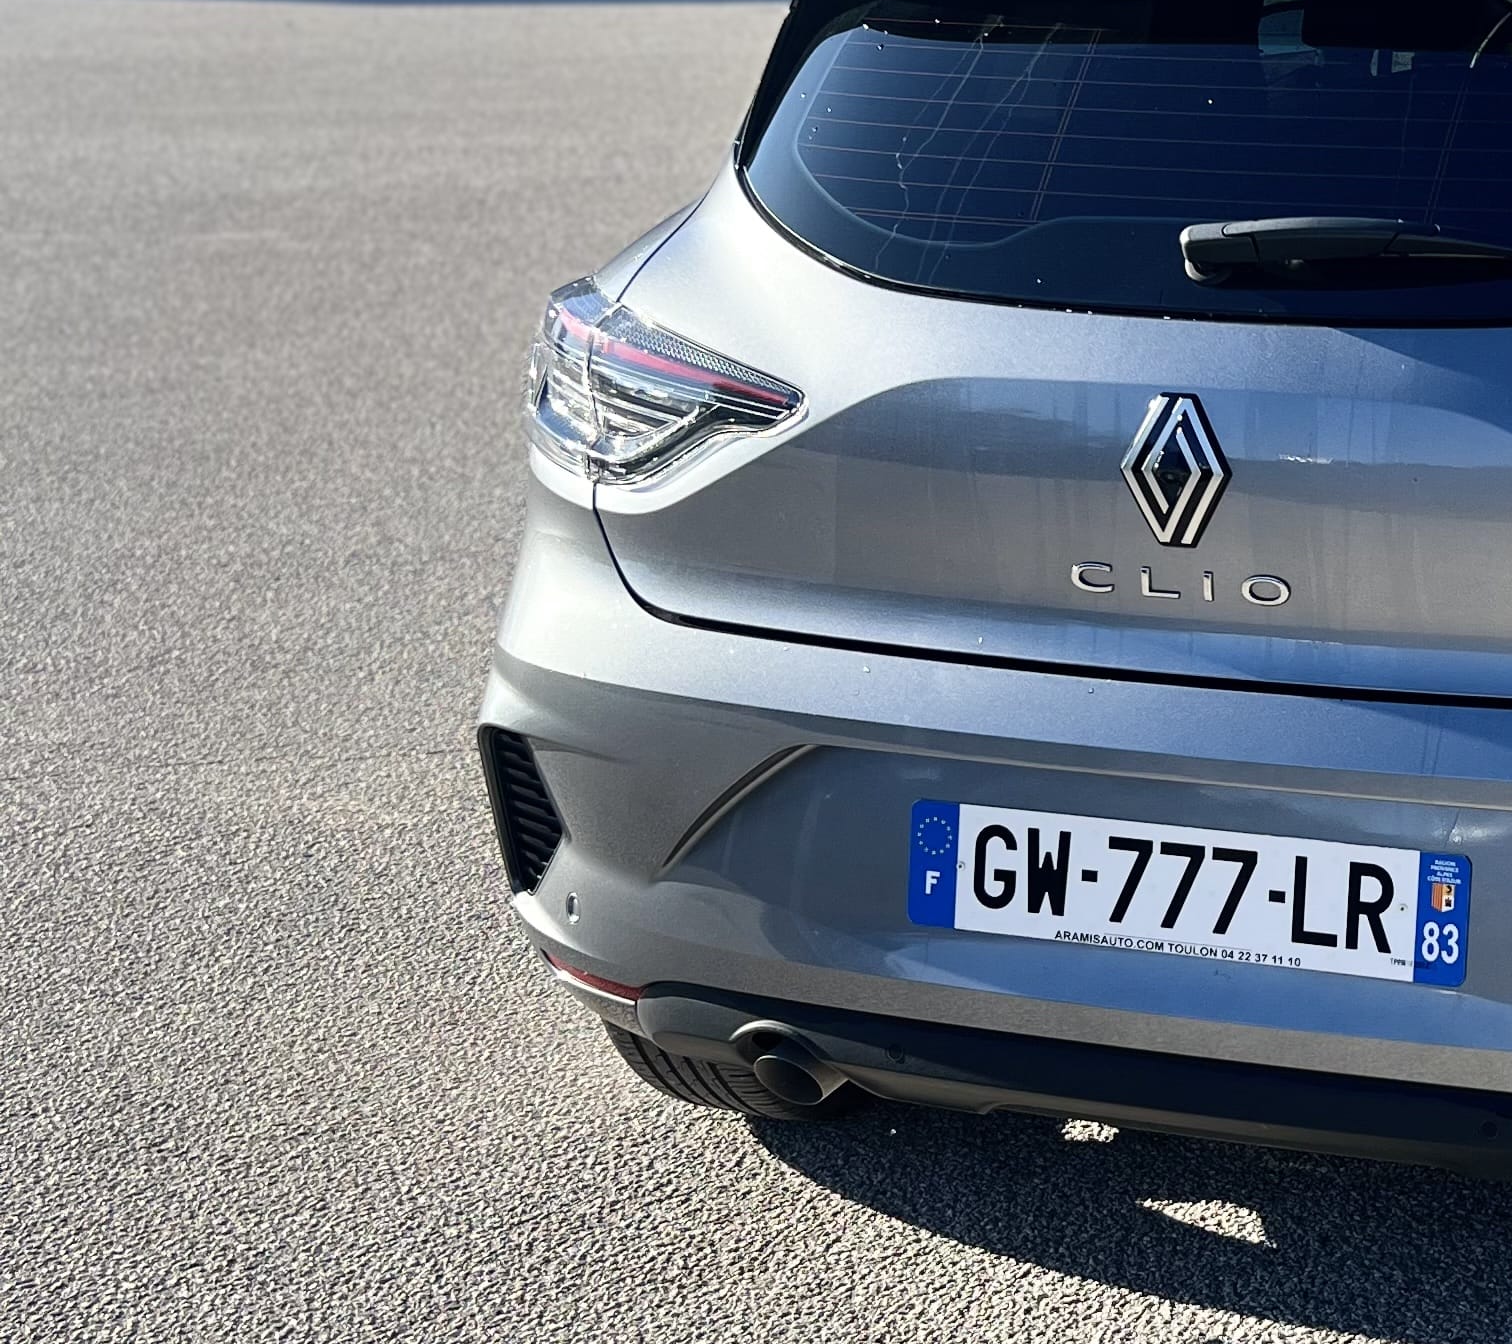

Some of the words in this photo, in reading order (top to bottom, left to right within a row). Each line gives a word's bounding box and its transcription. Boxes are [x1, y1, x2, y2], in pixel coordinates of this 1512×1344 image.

[1071, 561, 1292, 606] CLIO
[924, 869, 941, 895] F
[972, 823, 1394, 955] GW-777-LR
[1054, 929, 1165, 951] ARAMISAUTO.COM
[1168, 943, 1218, 958] TOULON
[1221, 949, 1234, 960] 04
[1238, 951, 1251, 962] 22
[1255, 953, 1268, 964] 37
[1272, 955, 1284, 966] 11
[1289, 957, 1302, 968] 10
[1422, 921, 1459, 965] 83
